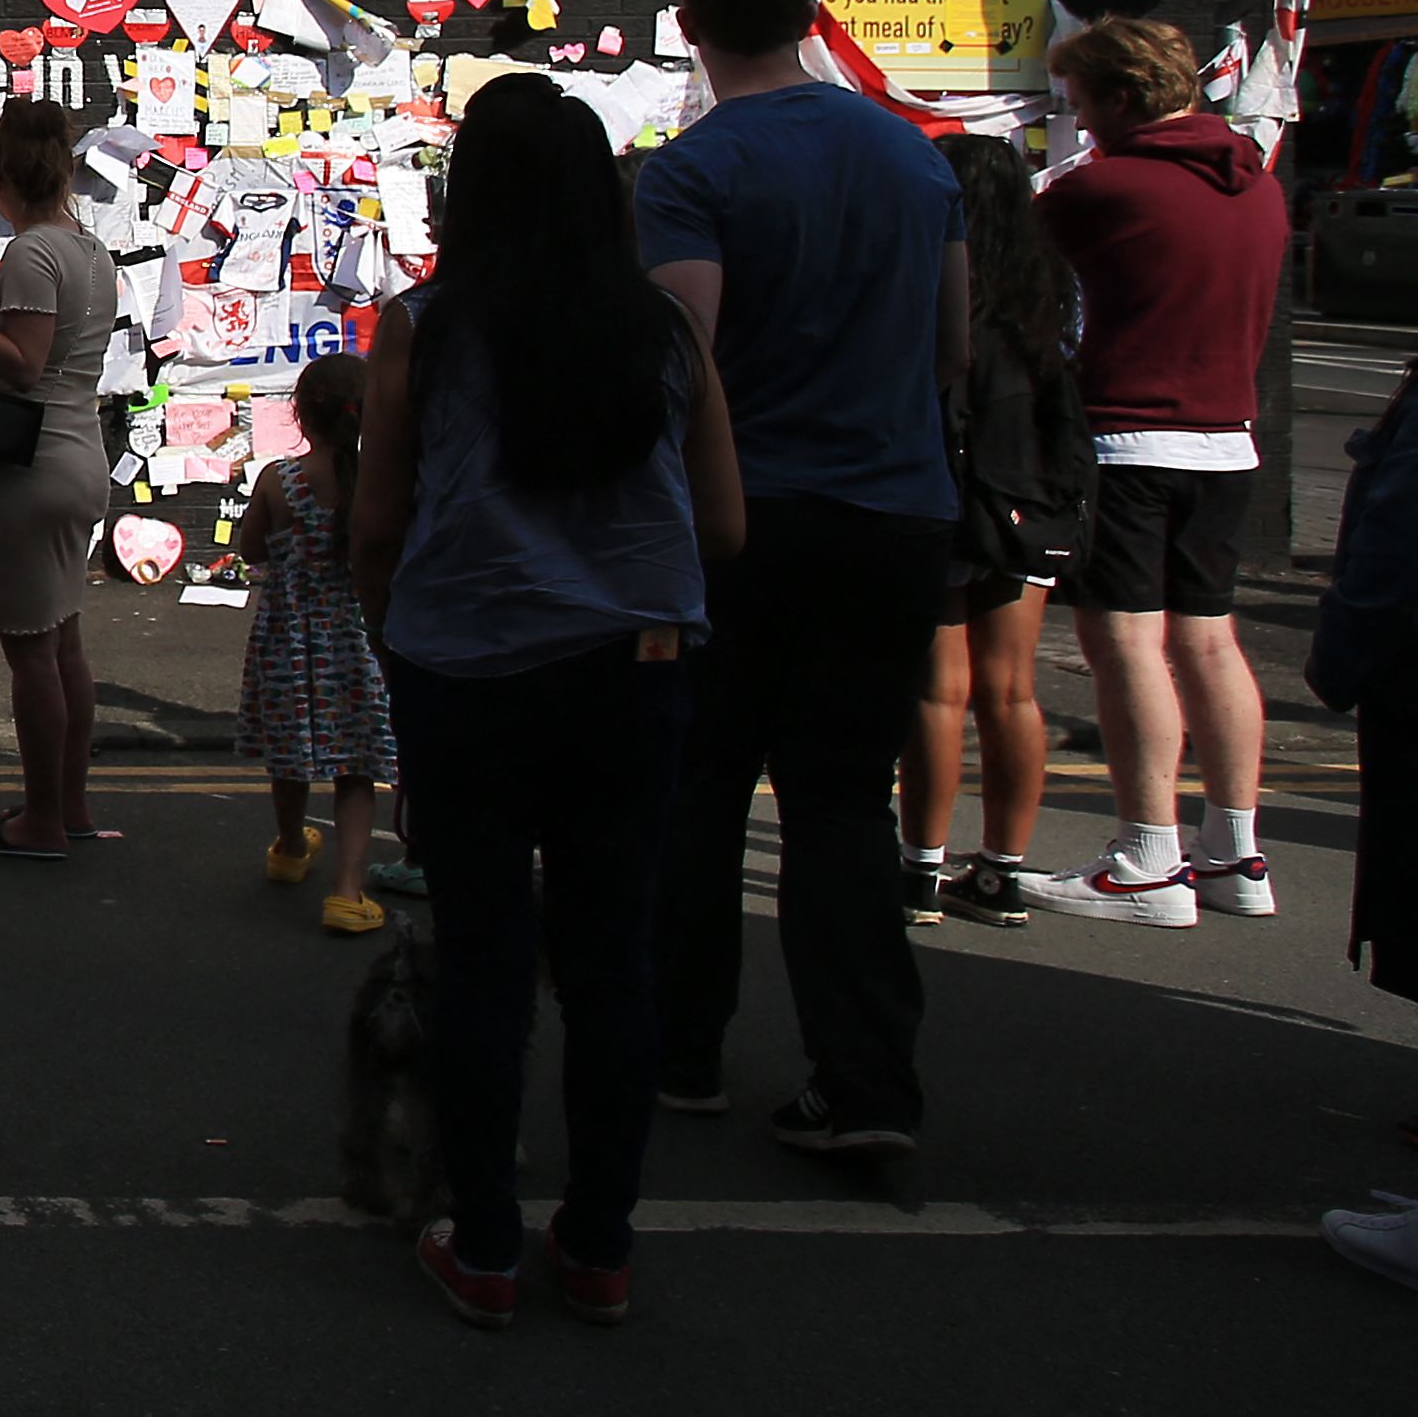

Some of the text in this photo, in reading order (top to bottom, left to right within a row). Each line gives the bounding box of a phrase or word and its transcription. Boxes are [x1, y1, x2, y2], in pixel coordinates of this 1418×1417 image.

[864, 15, 910, 39] meal
[916, 15, 934, 39] of
[1001, 15, 1033, 46] ay?
[169, 193, 208, 214] ENGLAND
